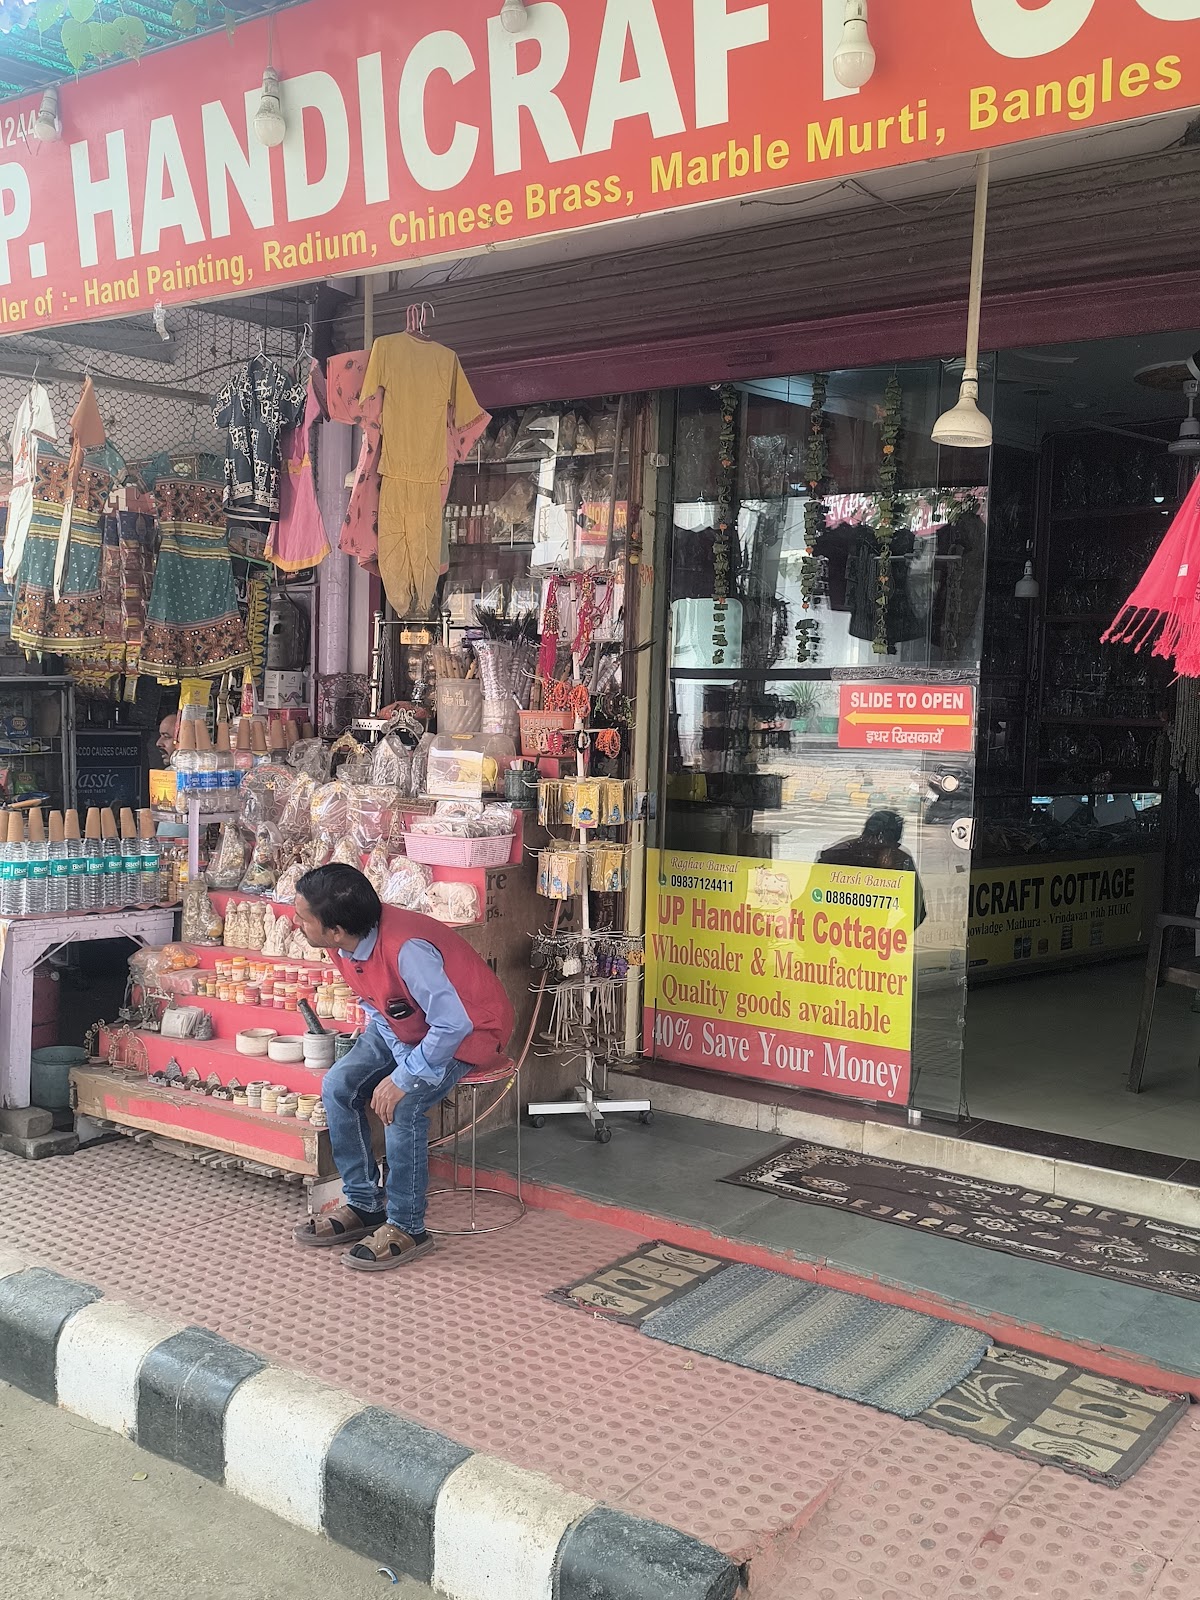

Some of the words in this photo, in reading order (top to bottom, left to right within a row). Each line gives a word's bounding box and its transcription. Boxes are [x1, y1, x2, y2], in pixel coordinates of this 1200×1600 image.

[34, 287, 53, 317] of
[84, 269, 140, 308] Hand
[147, 254, 254, 295] Painting,
[263, 229, 378, 273] Radium,
[389, 198, 514, 248] Chinese
[525, 174, 634, 220] Brass,
[650, 133, 790, 194] Marble
[806, 98, 946, 163] Murti,
[969, 54, 1182, 132] Bangles
[850, 691, 893, 709] SLIDE
[896, 692, 917, 709] TO
[921, 692, 964, 710] OPEN
[866, 729, 890, 744] इधर
[91, 747, 115, 756] CAUSES
[115, 746, 138, 756] CANCER
[670, 856, 705, 873] Raghav
[706, 859, 740, 874] Bansal
[671, 874, 734, 893] 09837124411
[830, 871, 862, 886] Harsh
[864, 874, 904, 889] Bansal
[1050, 867, 1136, 907] COTTAGE
[825, 890, 900, 911] 08868097774
[658, 894, 685, 926] UP
[691, 897, 805, 942] Handicraft
[812, 911, 908, 960] Cottage
[1006, 916, 1041, 932] Mathura
[1050, 911, 1088, 925] Vrindavan
[1090, 907, 1106, 919] with
[651, 933, 744, 973] Wholesaler
[750, 947, 766, 976] &
[773, 949, 908, 996] Manufacturer
[662, 974, 729, 1015] Quality
[736, 990, 791, 1018] goods
[799, 1000, 891, 1034] available
[652, 1013, 694, 1051] 40%
[701, 1021, 750, 1062] Save
[758, 1031, 814, 1073] Your
[822, 1041, 903, 1098] Money
